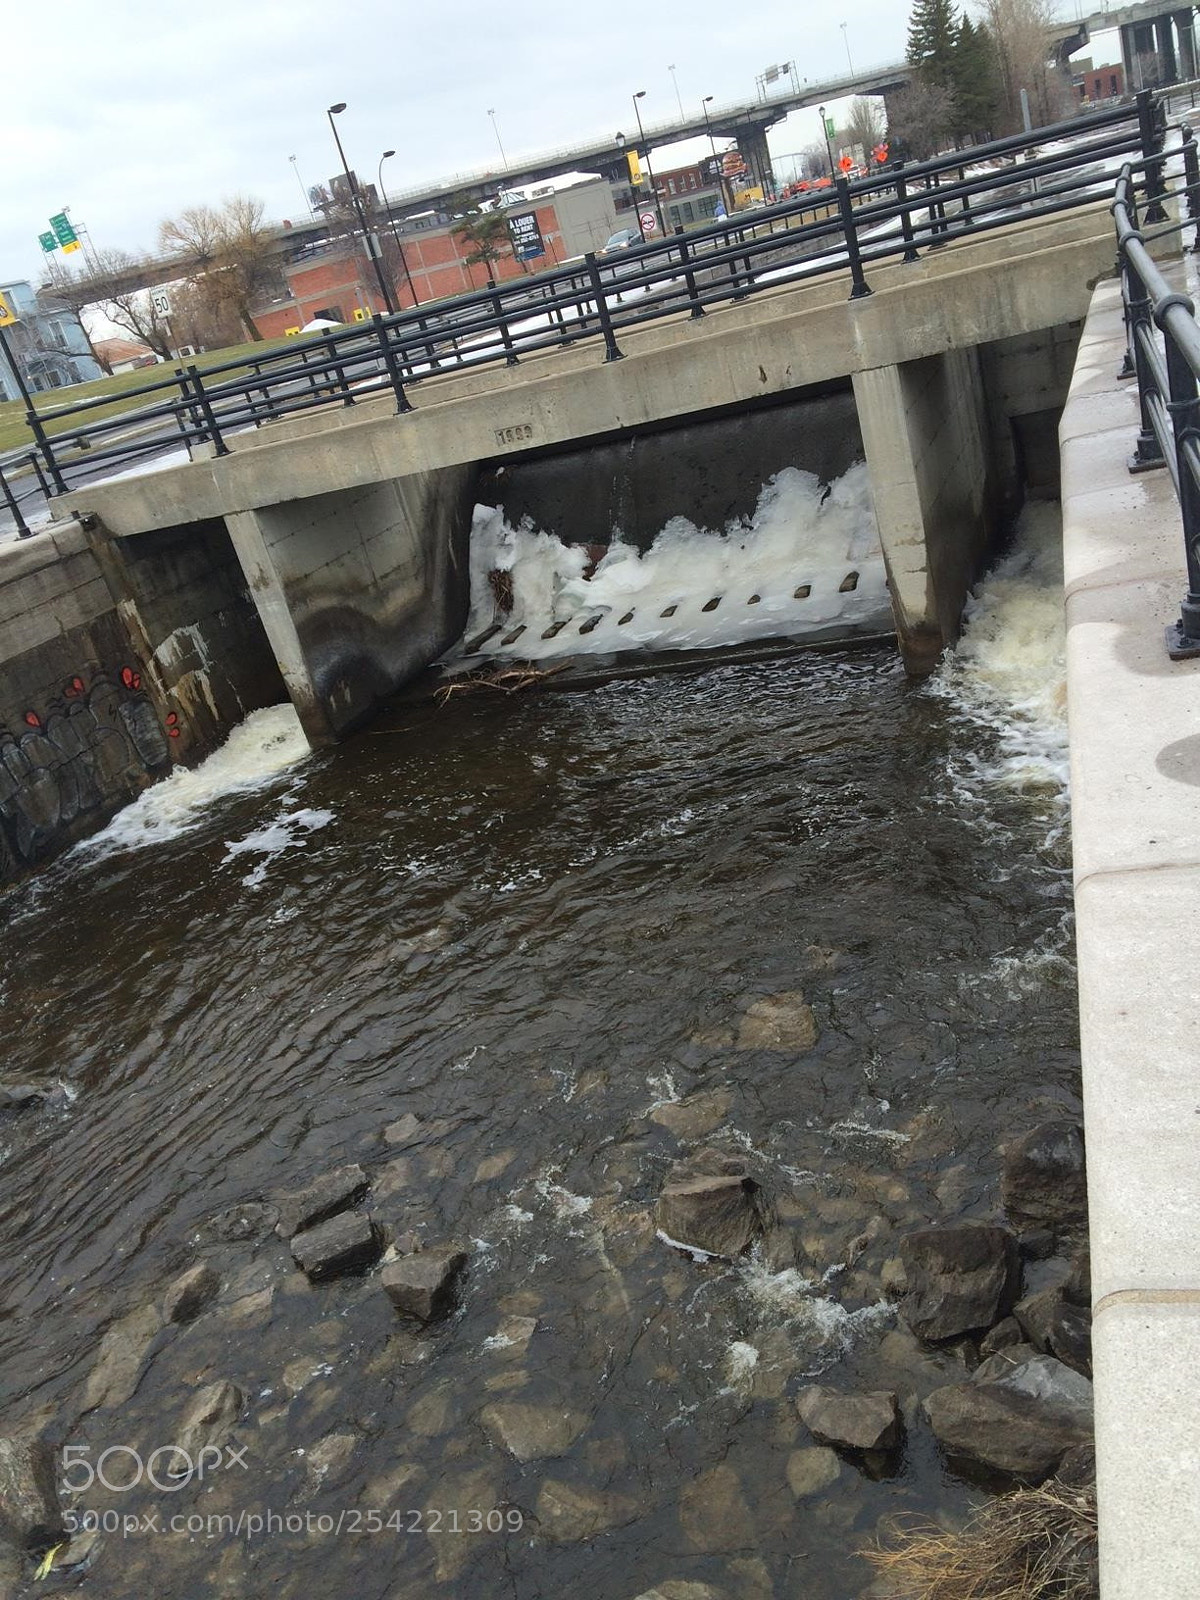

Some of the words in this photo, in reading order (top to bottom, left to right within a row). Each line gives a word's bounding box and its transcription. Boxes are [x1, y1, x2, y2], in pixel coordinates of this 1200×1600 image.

[514, 215, 535, 227] LOUER
[520, 224, 534, 232] RENT
[155, 296, 169, 313] 50
